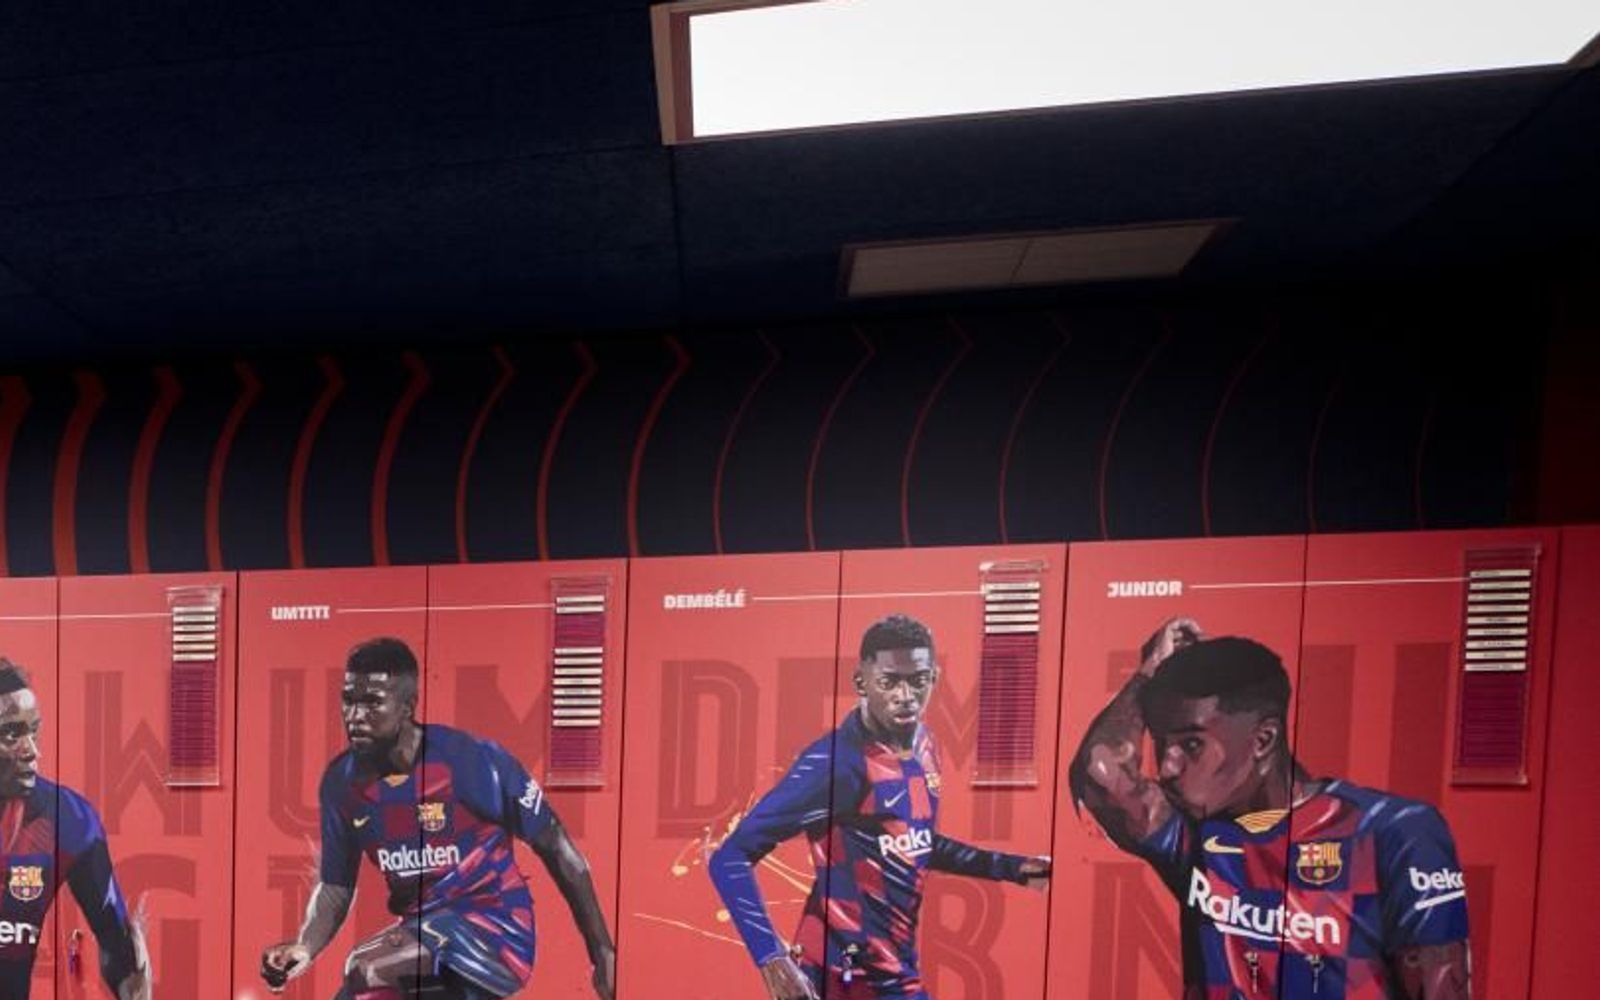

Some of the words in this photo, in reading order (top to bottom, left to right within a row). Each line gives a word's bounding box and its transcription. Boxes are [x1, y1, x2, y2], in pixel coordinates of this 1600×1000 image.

[663, 588, 746, 609] DEMBÉLÉ
[1106, 580, 1183, 599] JUNIOR
[271, 604, 330, 620] UMTITI
[378, 842, 460, 872] Rakuten
[1188, 866, 1341, 945] Rakuten
